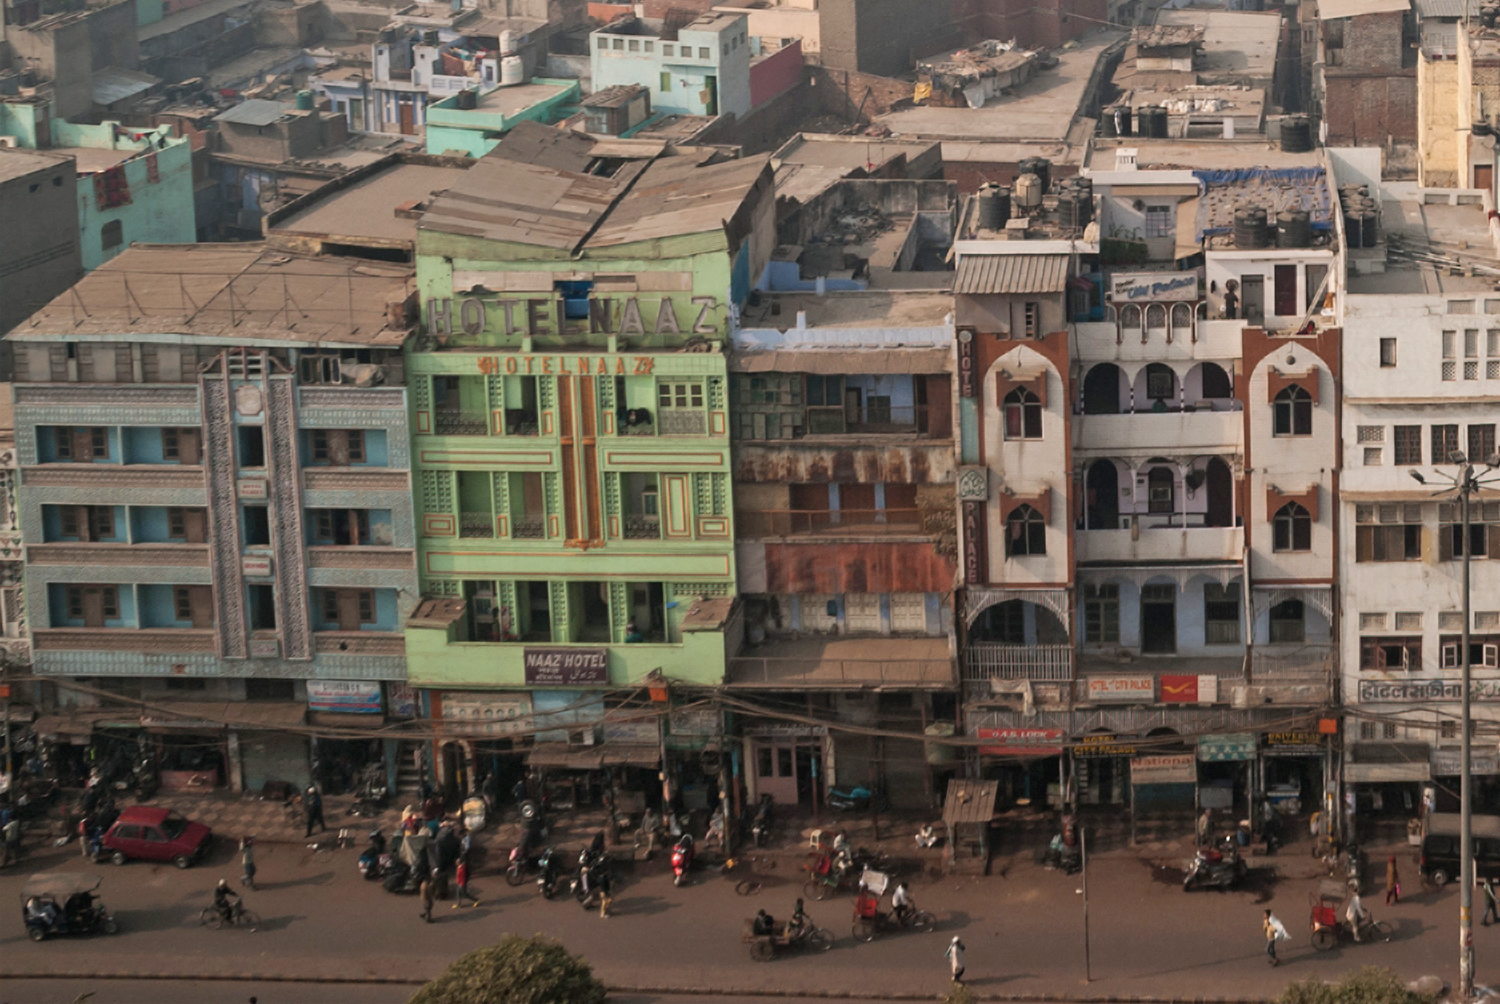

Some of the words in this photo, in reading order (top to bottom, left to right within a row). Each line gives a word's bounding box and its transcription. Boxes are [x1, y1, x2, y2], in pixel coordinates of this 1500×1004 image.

[427, 297, 580, 336] HOTEL
[589, 296, 718, 335] NAAZ
[488, 357, 572, 375] HOTEL
[578, 356, 645, 375] NAAZ
[964, 502, 977, 583] PALACE
[526, 653, 560, 667] NAAZ
[564, 653, 606, 668] HOTEL
[1090, 679, 1109, 691] HOTEL
[1114, 679, 1129, 691] CITY
[1130, 679, 1152, 691] PALACE
[1131, 756, 1194, 766] National
